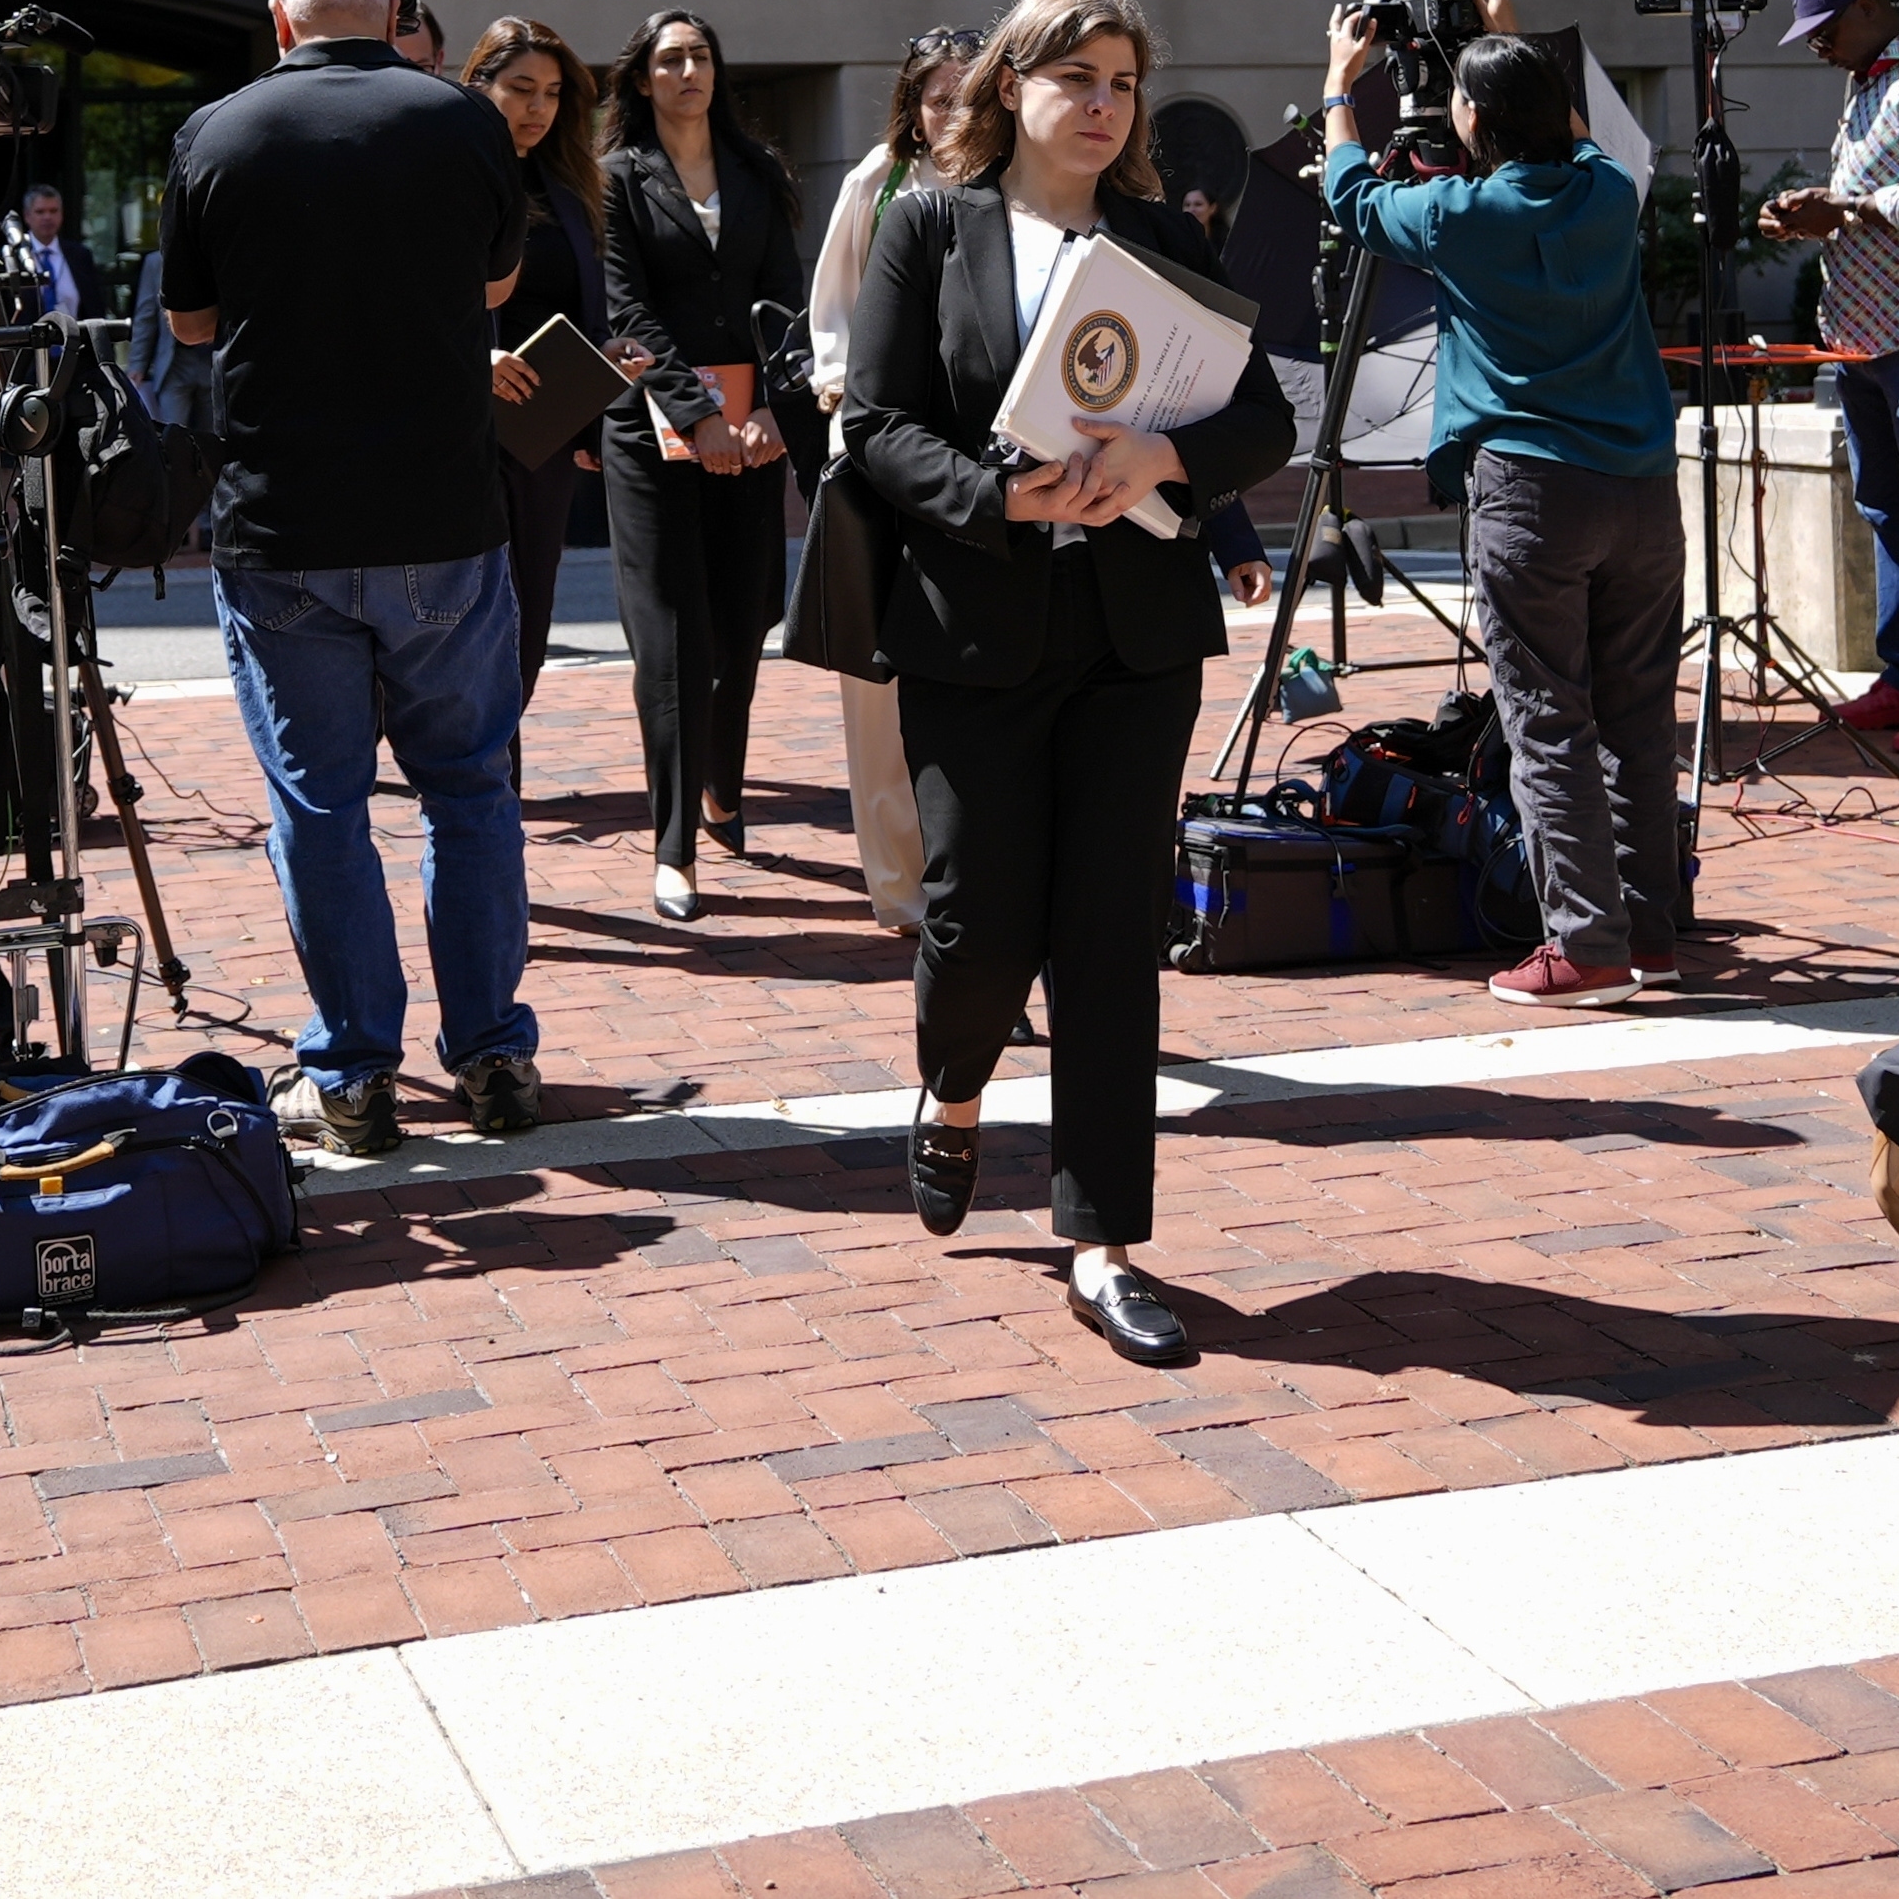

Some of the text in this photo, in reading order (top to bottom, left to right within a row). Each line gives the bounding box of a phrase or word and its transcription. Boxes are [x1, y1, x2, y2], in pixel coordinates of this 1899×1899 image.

[1130, 400, 1144, 427] TATES
[41, 1251, 91, 1274] porta
[42, 1273, 92, 1294] brace
